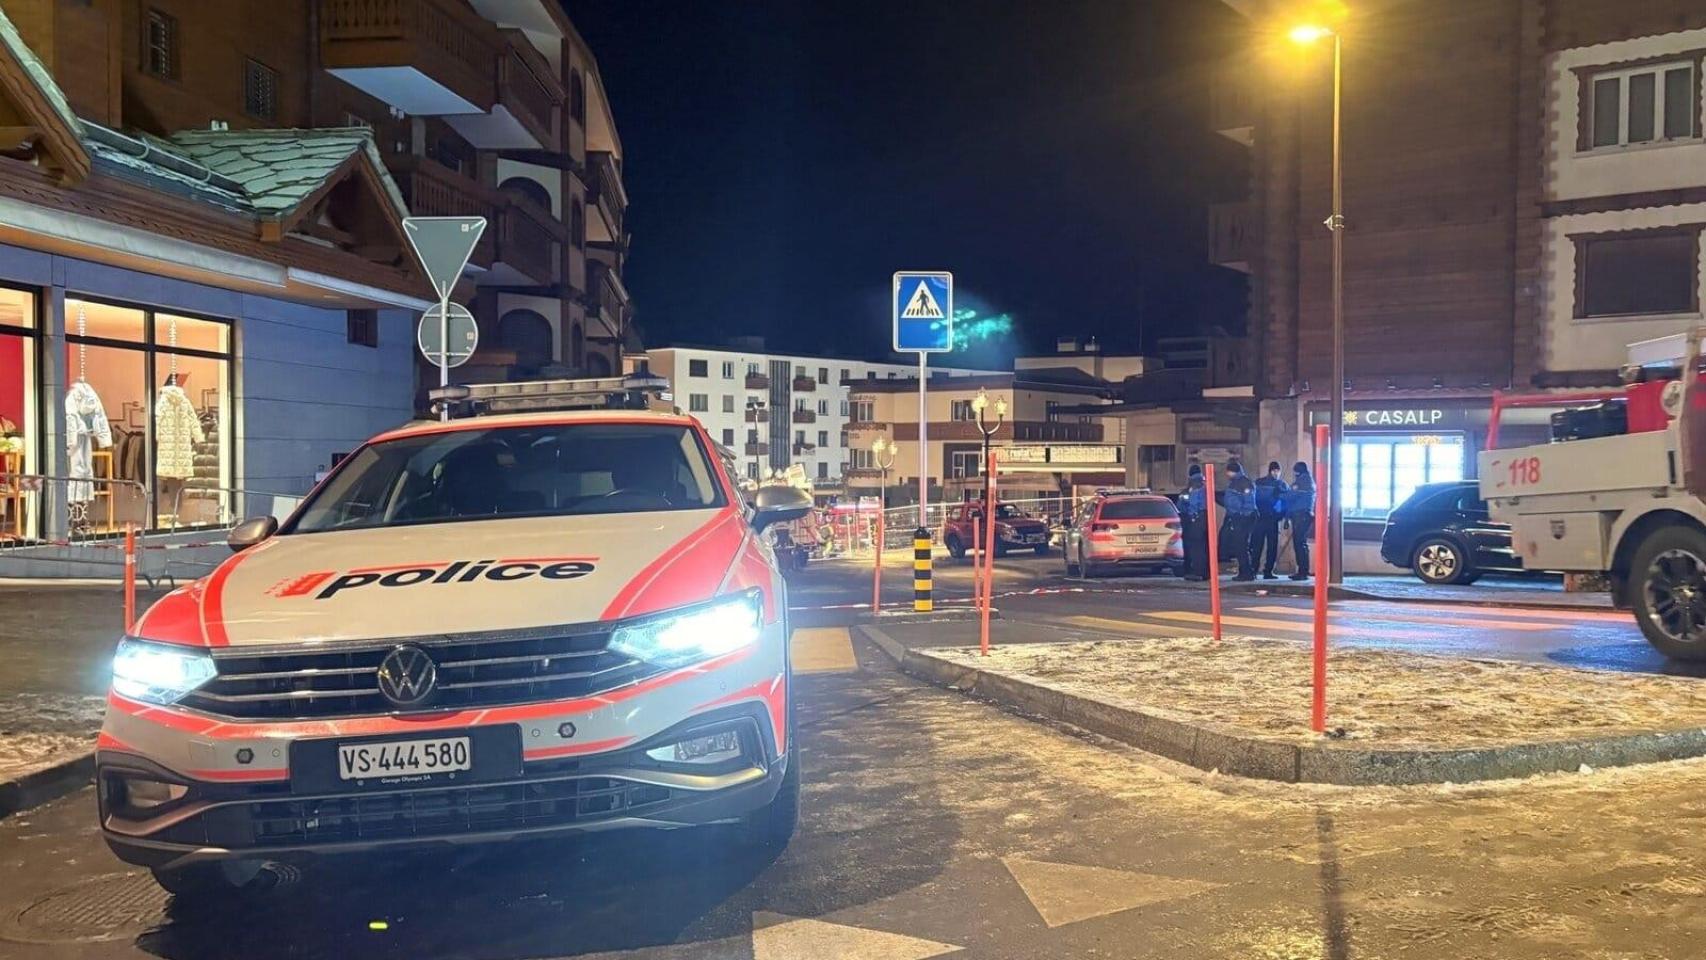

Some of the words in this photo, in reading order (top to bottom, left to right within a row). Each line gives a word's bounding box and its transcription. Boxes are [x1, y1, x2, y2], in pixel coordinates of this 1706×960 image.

[1366, 410, 1442, 425] CASALP
[1509, 457, 1540, 485] 118
[315, 559, 596, 600] police
